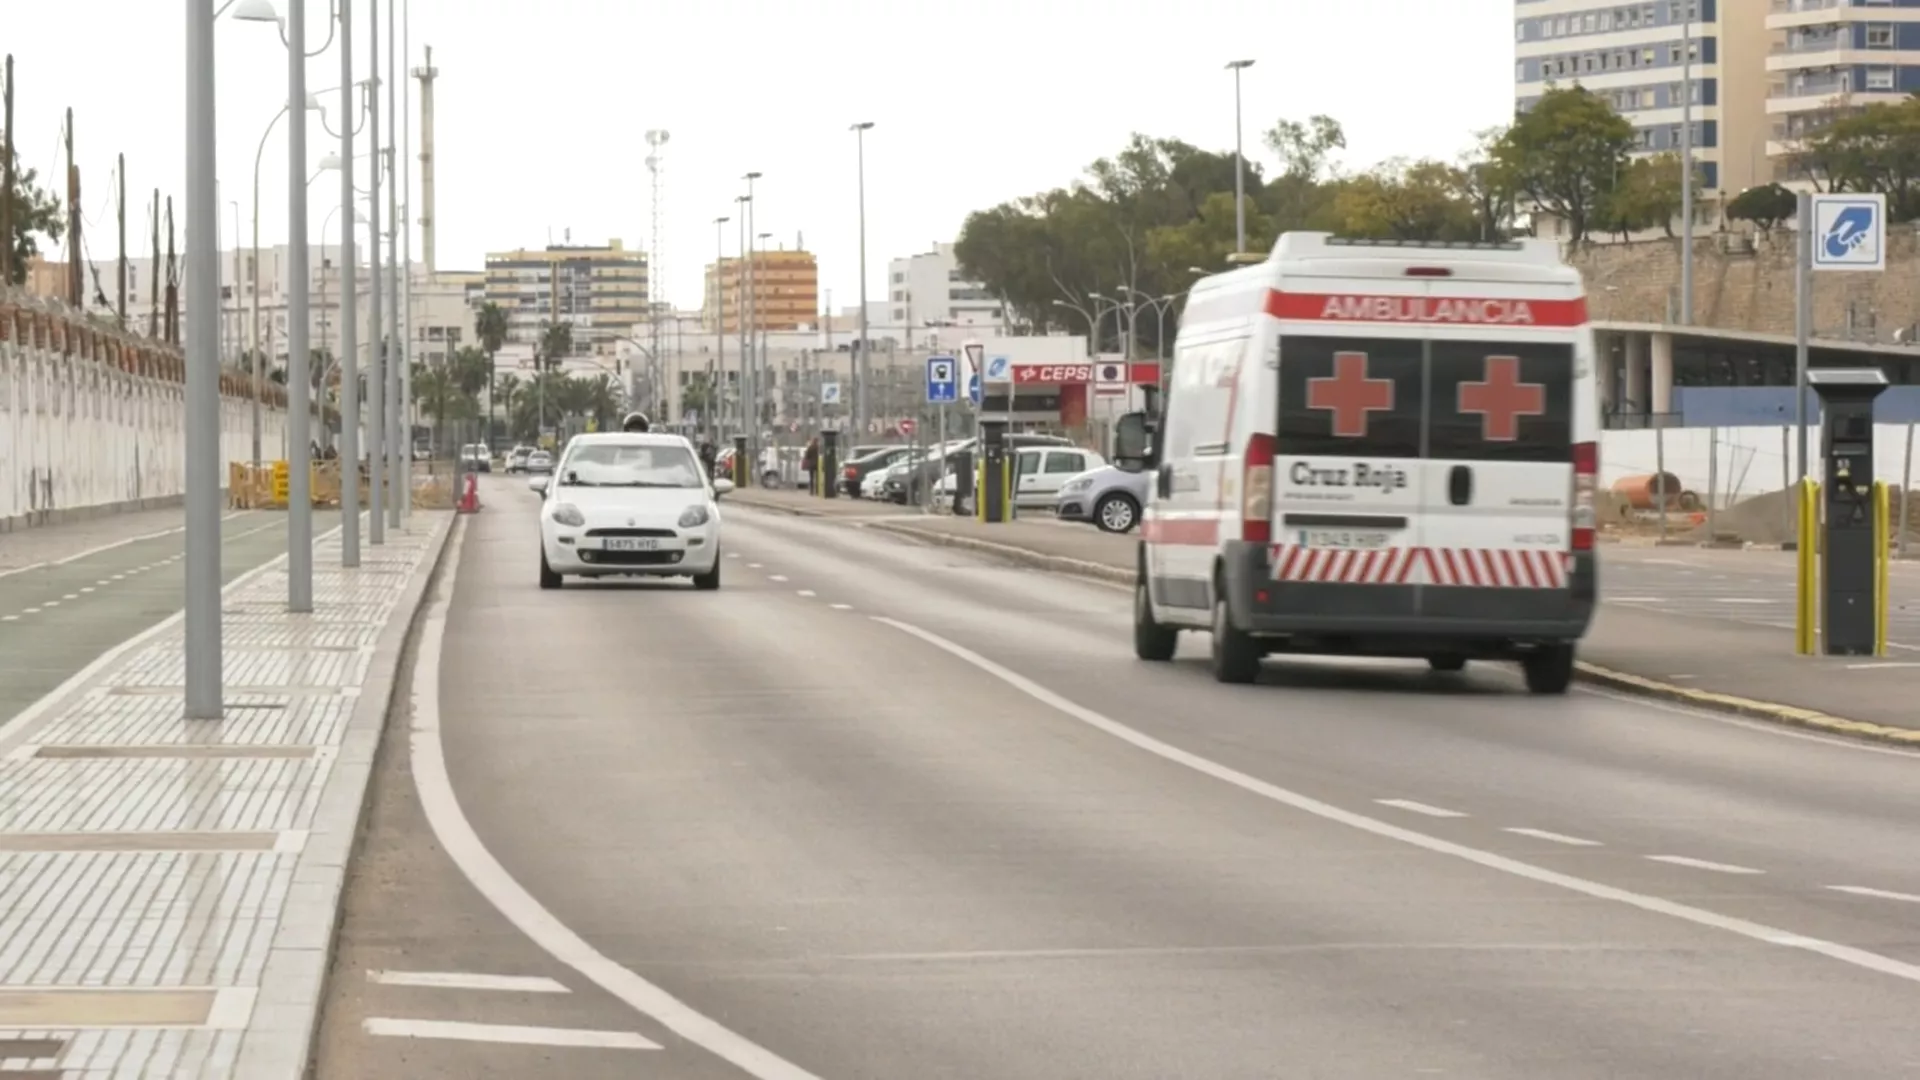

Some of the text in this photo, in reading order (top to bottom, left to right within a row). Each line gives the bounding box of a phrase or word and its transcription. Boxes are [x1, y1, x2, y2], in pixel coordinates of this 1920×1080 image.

[1320, 296, 1534, 323] AMBULANCIA
[1040, 366, 1092, 380] CEPS
[1289, 461, 1407, 494] Cruz Roja
